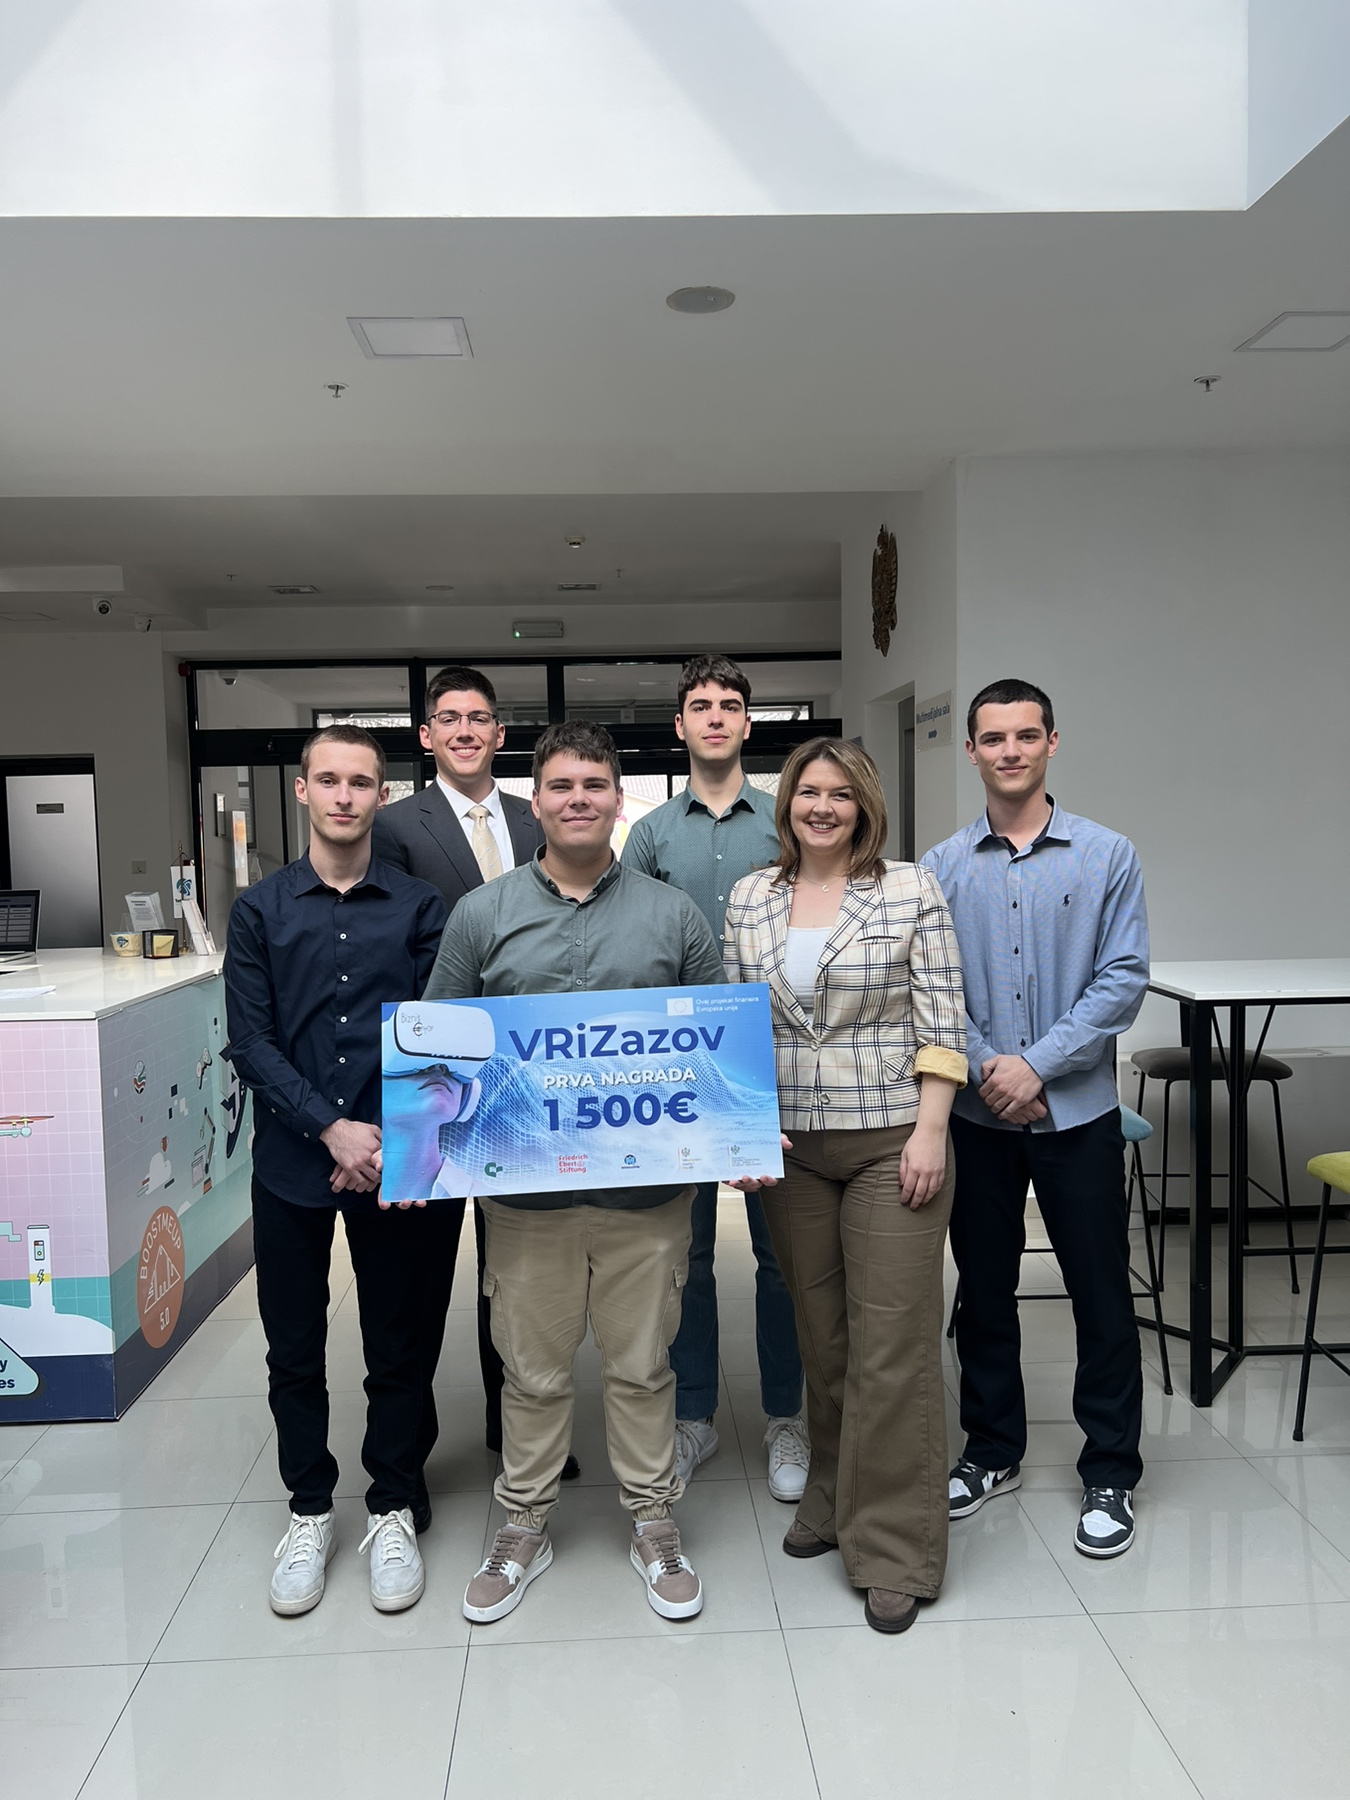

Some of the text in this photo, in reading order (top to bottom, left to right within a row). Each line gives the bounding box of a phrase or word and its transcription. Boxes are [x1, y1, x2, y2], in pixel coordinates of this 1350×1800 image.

[696, 1005, 723, 1013] Evropska
[710, 997, 734, 1005] projekat
[508, 1022, 726, 1062] VRiZazov
[543, 1067, 698, 1089] PRVA NAGRADA
[543, 1091, 699, 1131] 1 500€
[139, 1212, 182, 1280] BOOSTMEUP
[159, 1306, 170, 1331] 5.0
